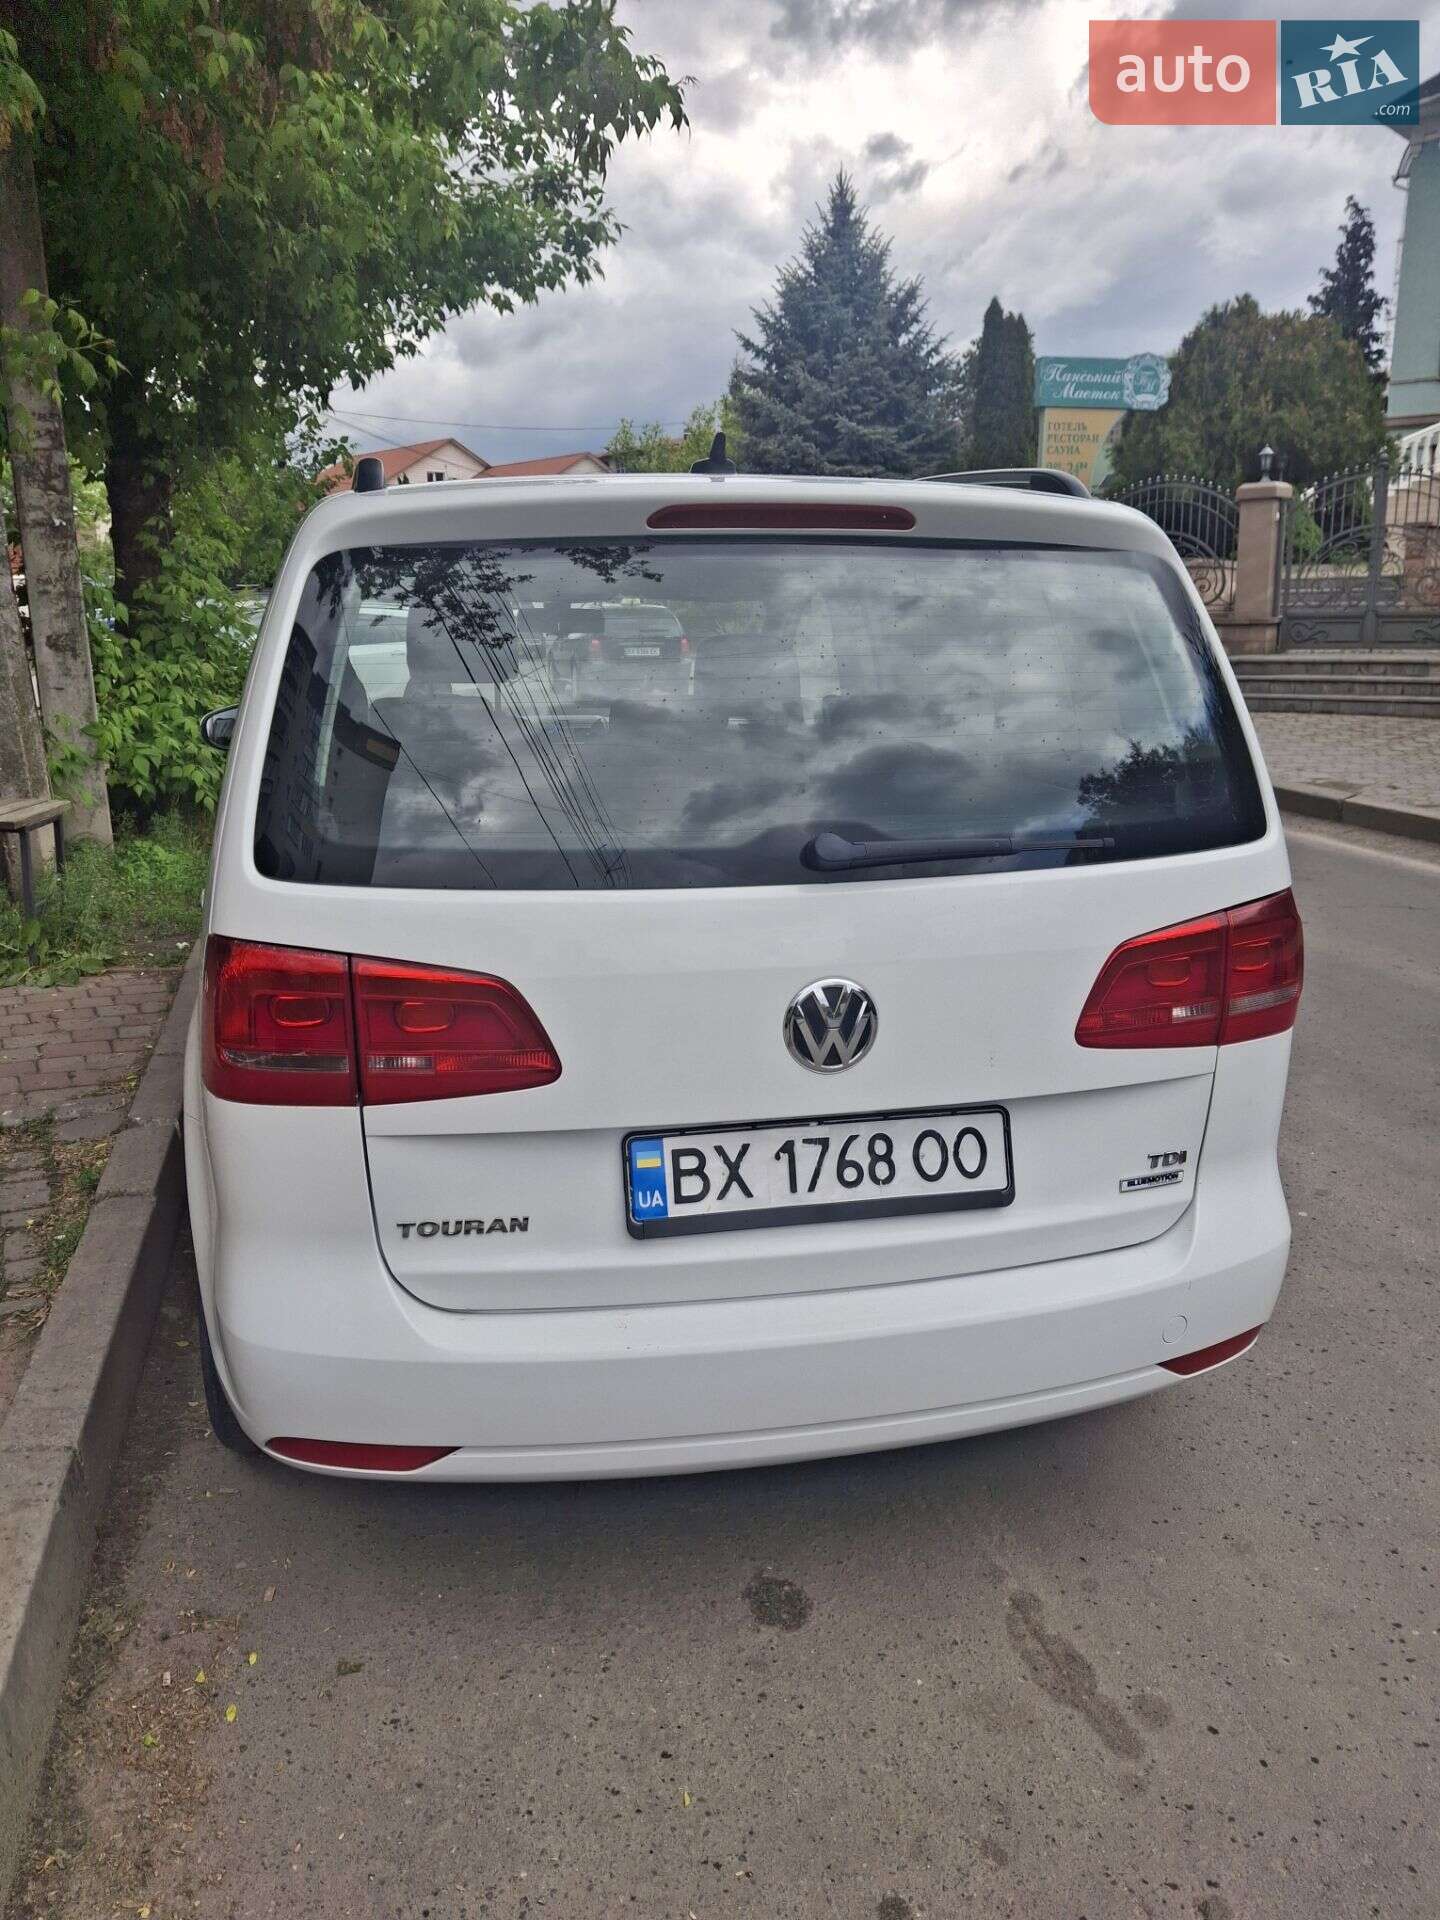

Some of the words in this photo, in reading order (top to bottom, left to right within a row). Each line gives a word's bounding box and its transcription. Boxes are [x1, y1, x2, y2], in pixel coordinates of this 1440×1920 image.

[1043, 363, 1122, 384] Панський
[1048, 422, 1087, 432] ГОТЕЛЬ
[1047, 433, 1100, 443] РЕСТОРАН
[1047, 445, 1081, 455] САУНА
[774, 1132, 896, 1194] 1768
[1147, 1150, 1187, 1169] TDI
[638, 1189, 664, 1208] UA
[396, 1216, 529, 1239] TOURAN
